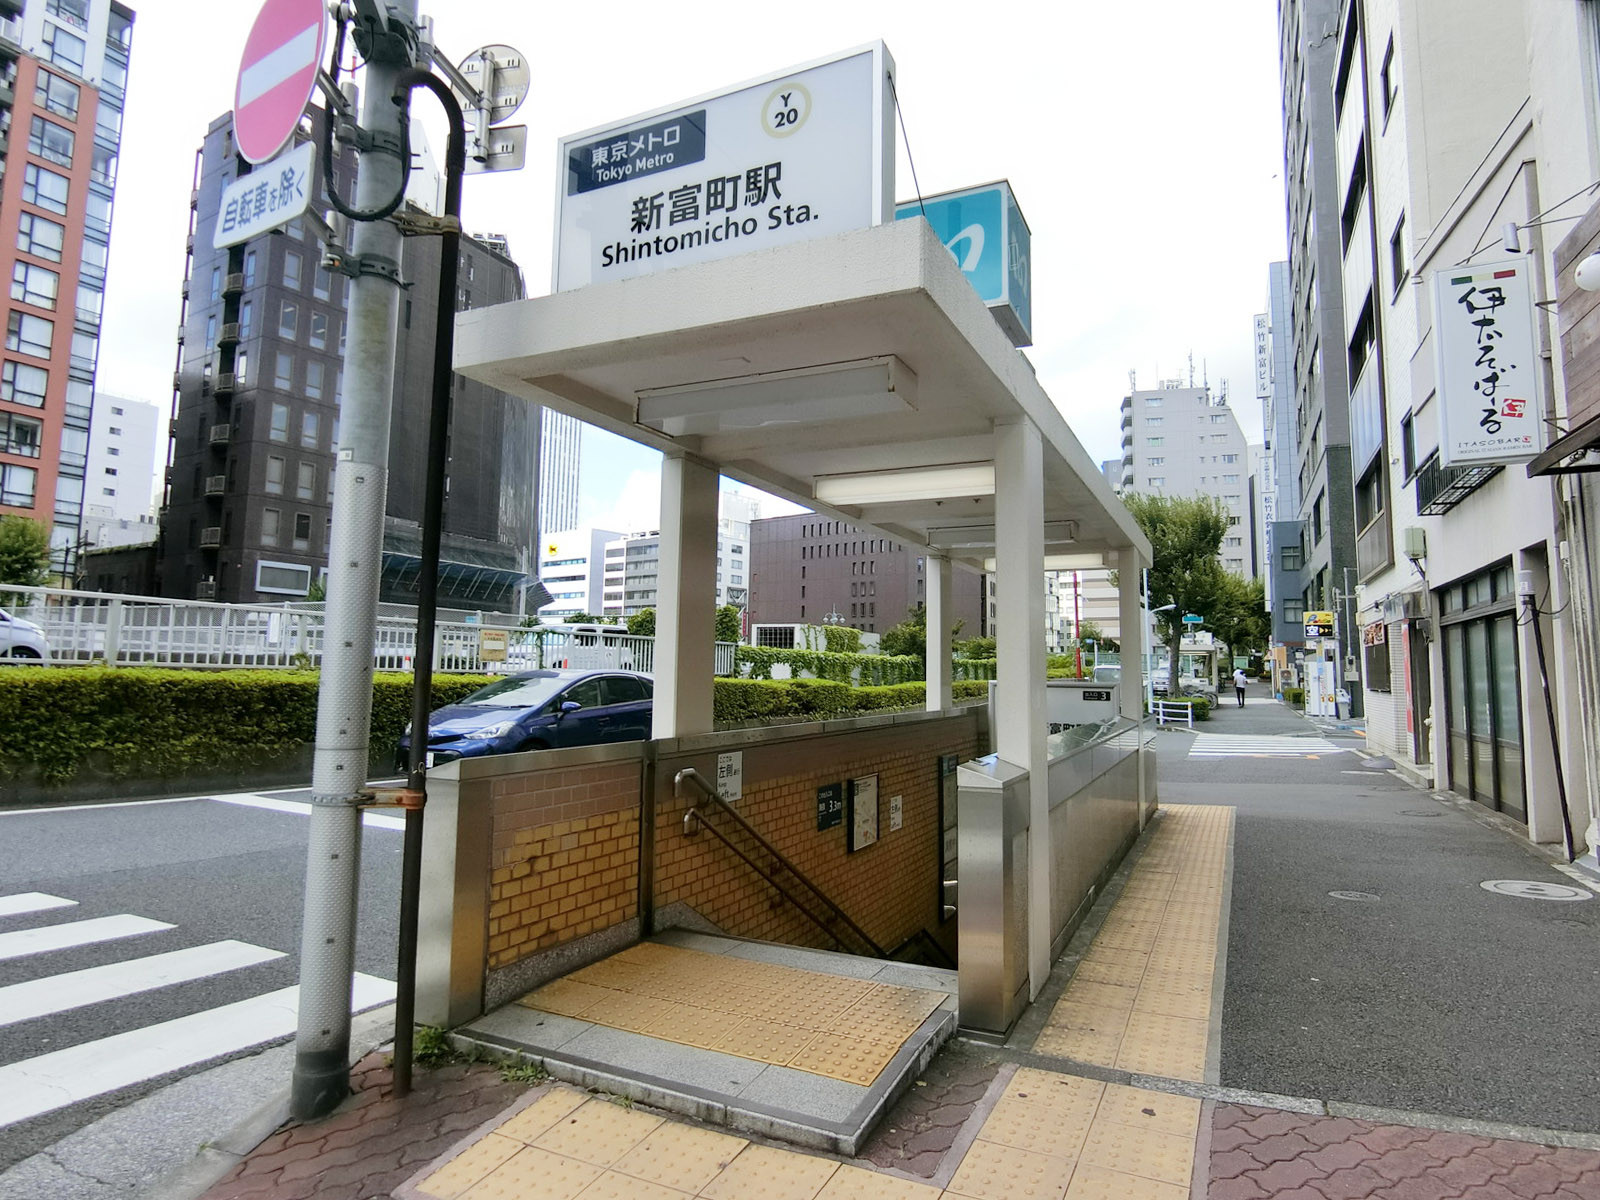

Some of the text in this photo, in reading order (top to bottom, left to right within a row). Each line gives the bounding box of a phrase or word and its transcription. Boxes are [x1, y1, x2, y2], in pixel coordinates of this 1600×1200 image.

[781, 92, 792, 107] Y
[775, 108, 798, 128] 20
[591, 125, 680, 168] 東京メトロ
[596, 152, 674, 182] Tokyo Metro
[222, 166, 305, 233] 自転車を除く
[630, 161, 782, 234] 新富町駅
[602, 204, 819, 267] Shintomicho Sta.
[1257, 319, 1268, 391] 松竹新富ビル
[1458, 437, 1520, 448] ITASOBAR
[1100, 691, 1107, 700] 3
